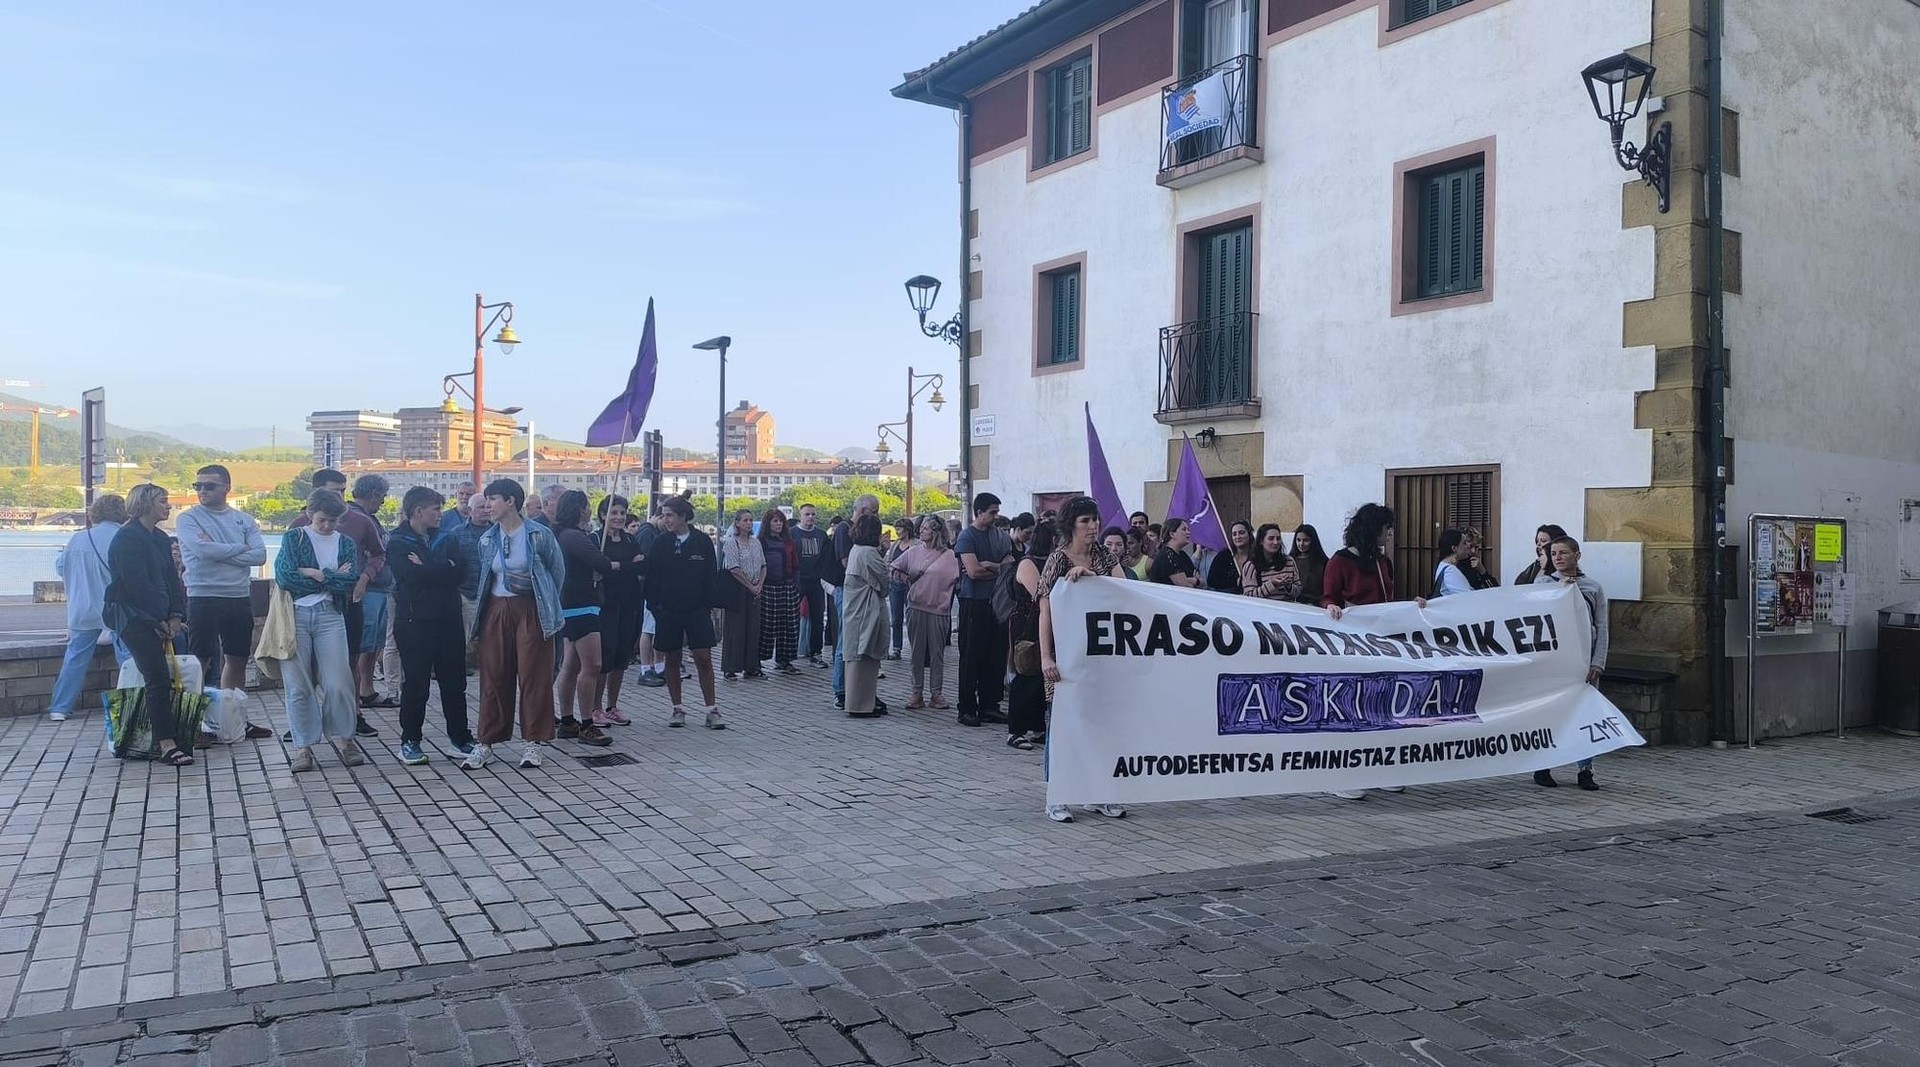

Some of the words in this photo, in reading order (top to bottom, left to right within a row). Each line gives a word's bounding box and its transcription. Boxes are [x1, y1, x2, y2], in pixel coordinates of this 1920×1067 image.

[1184, 118, 1220, 134] SOCIEDAD
[1085, 611, 1244, 656] ERASO
[1252, 620, 1508, 660] MATXISTARIK
[1505, 614, 1559, 655] EZ!
[1238, 681, 1364, 723] ASKI
[1390, 678, 1465, 718] DA!
[1579, 716, 1624, 744] ZMF
[1112, 752, 1275, 778] AUTODEFENTSA
[1280, 746, 1396, 771] FEMINISTAZ
[1399, 734, 1509, 764] ERANTZUNGO
[1510, 728, 1557, 751] DUGU!
